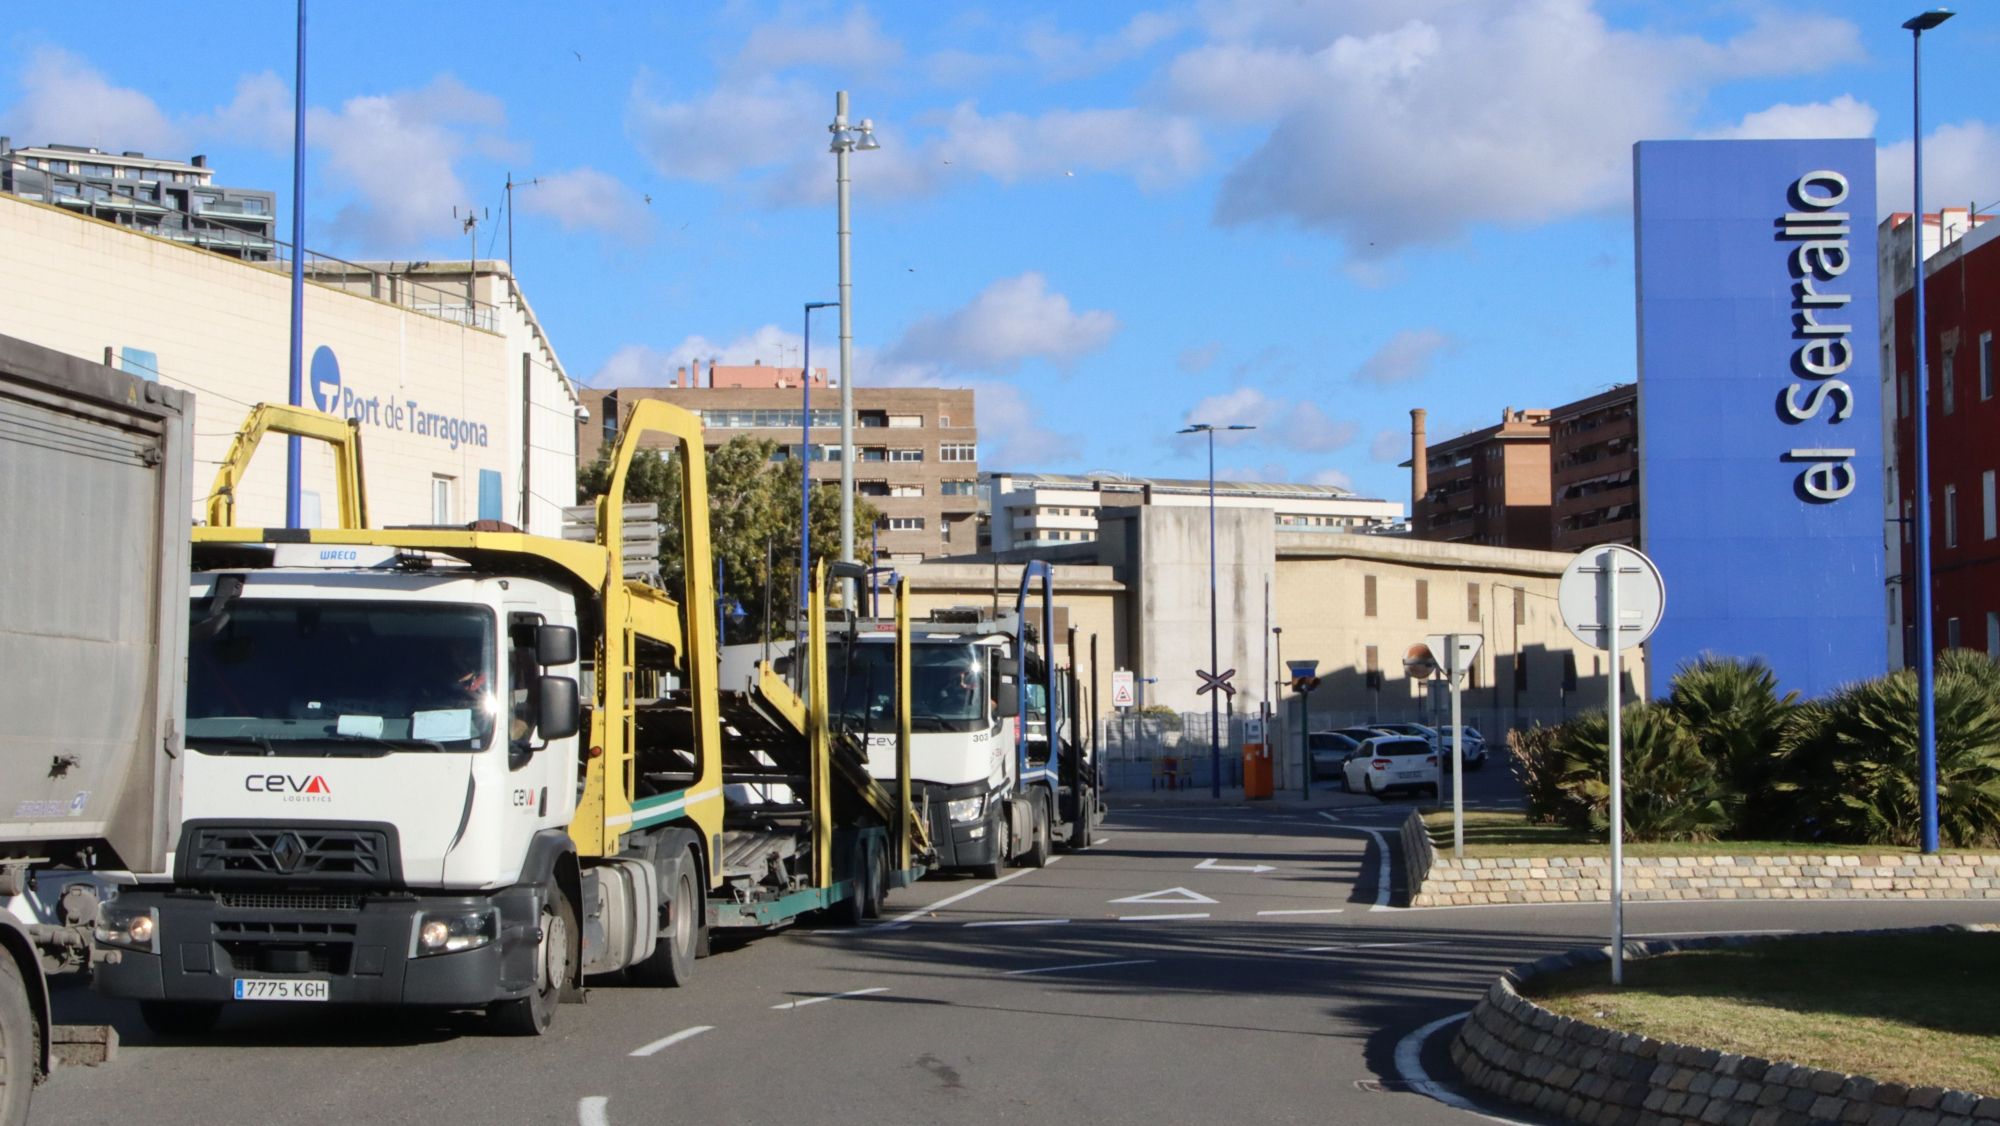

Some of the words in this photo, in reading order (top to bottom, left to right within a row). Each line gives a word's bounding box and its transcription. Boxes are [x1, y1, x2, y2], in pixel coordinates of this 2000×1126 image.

[1785, 169, 1854, 420] Serrallo
[343, 386, 380, 426] Port
[384, 394, 404, 431] de
[406, 400, 488, 450] Tarragona
[1790, 448, 1856, 500] el
[320, 550, 357, 561] WAECO
[867, 736, 897, 747] CEV
[247, 981, 288, 997] 7775
[294, 982, 325, 998] KGH
